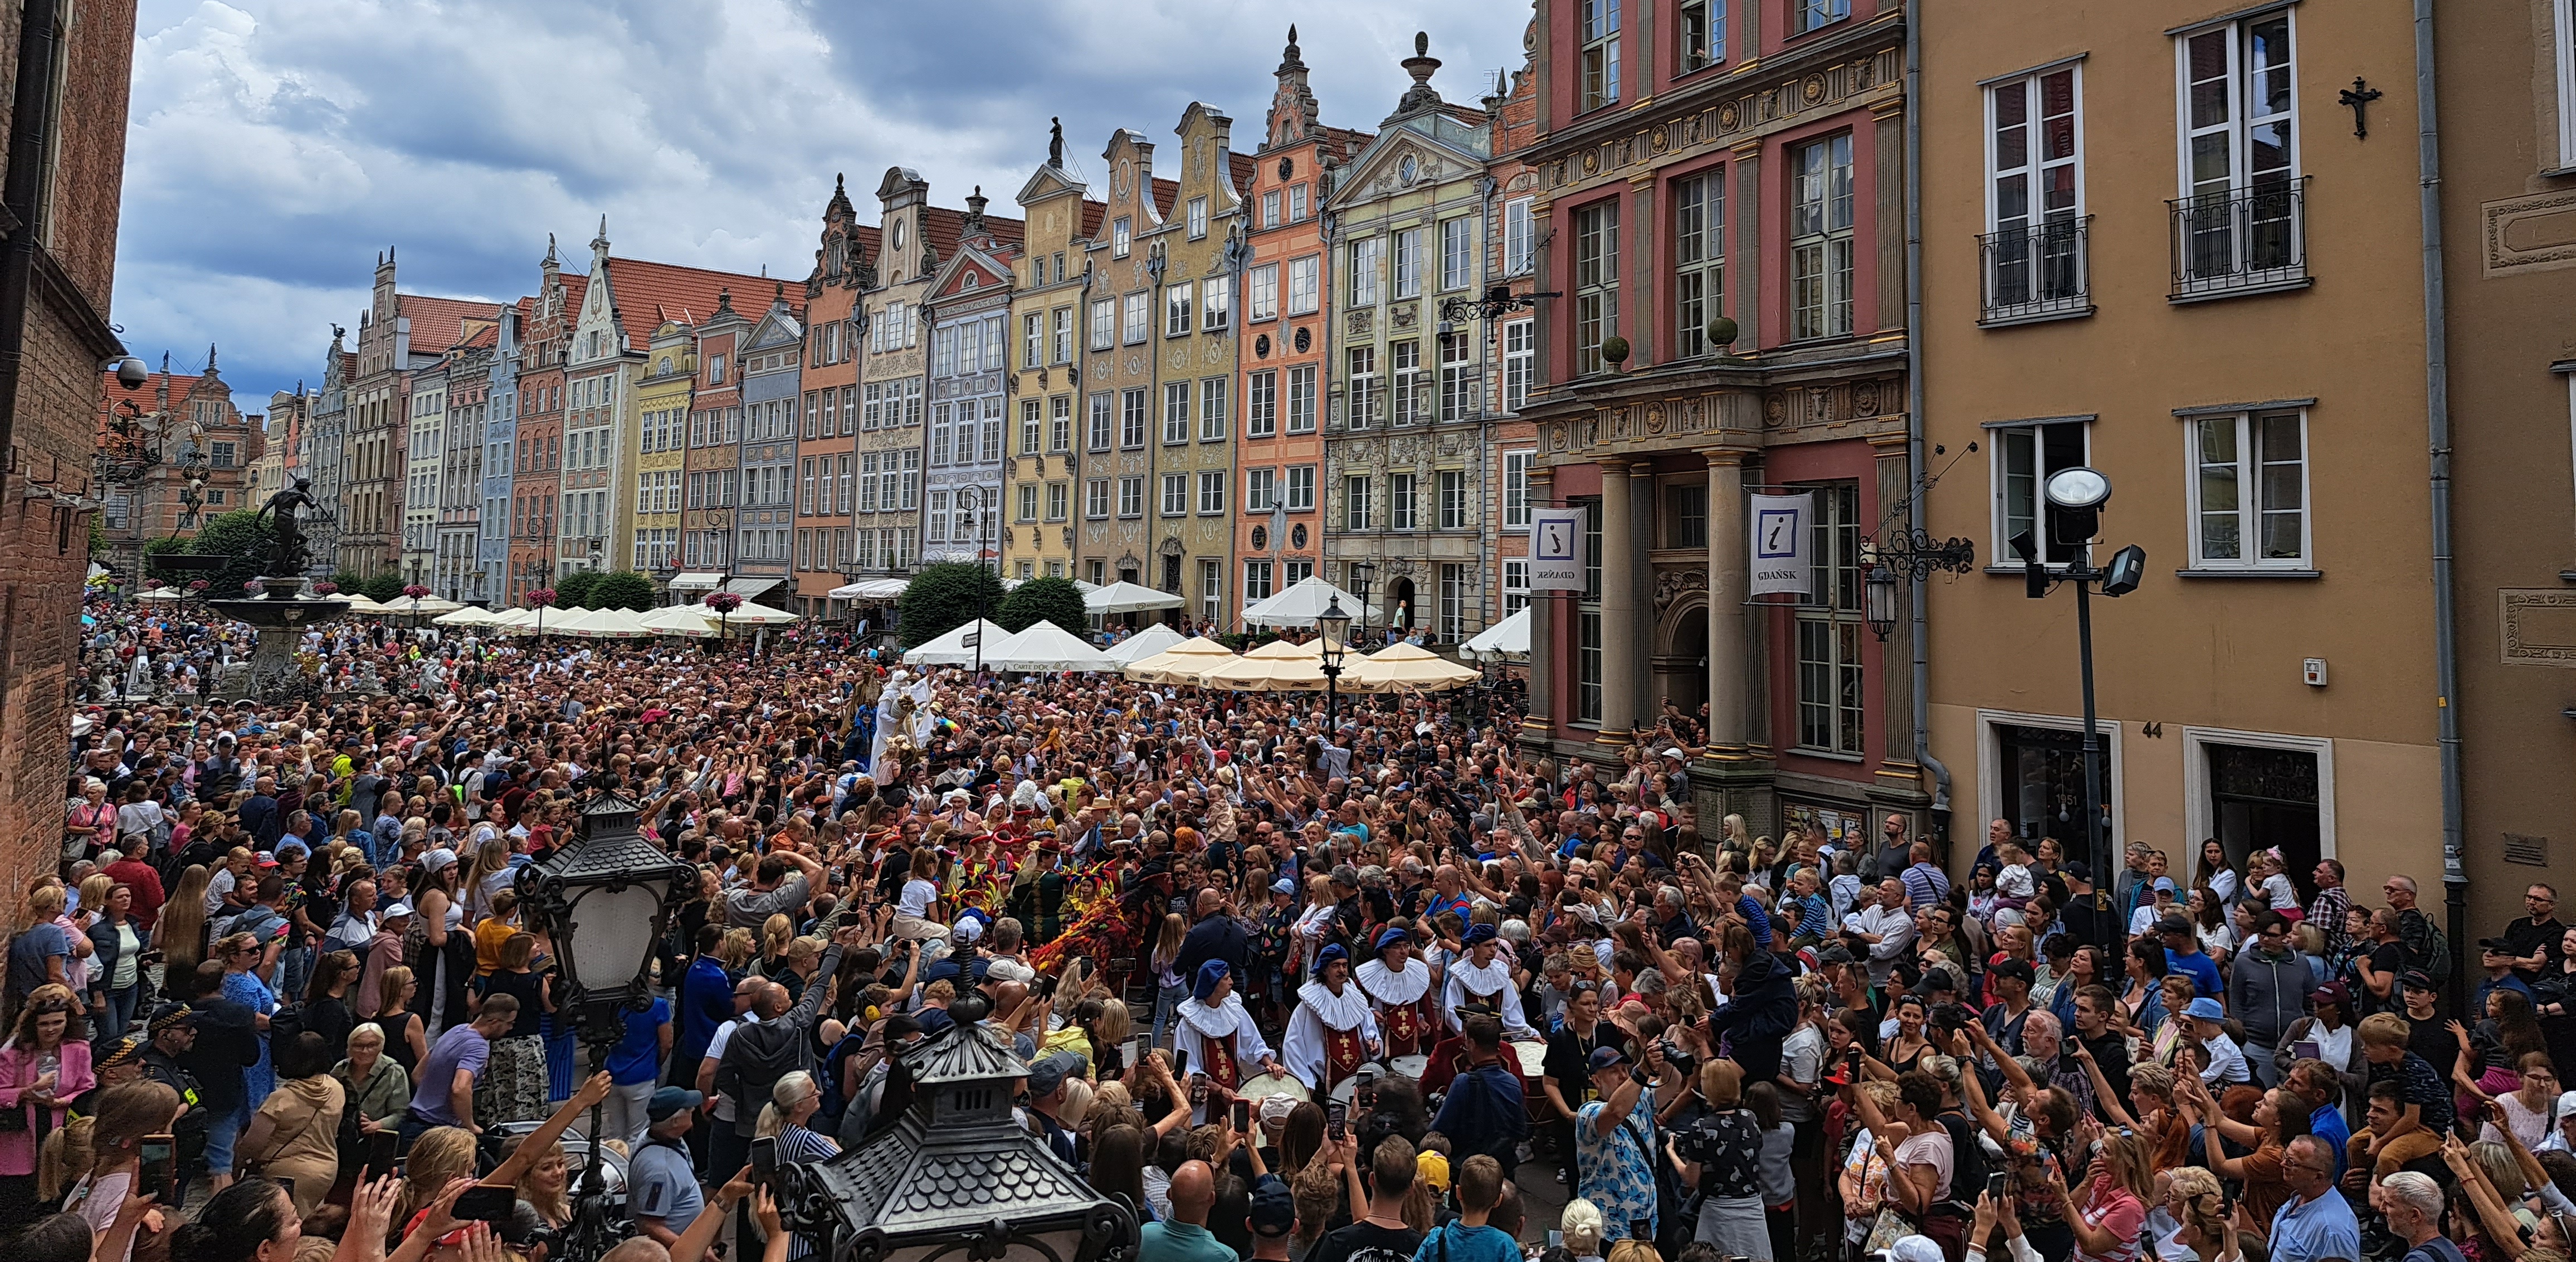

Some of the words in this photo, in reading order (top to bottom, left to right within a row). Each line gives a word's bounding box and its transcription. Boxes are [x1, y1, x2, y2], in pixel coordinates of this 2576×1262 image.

[1758, 568, 1797, 581] GDAŃSK
[2142, 720, 2162, 739] 44
[2056, 793, 2077, 806] 1951
